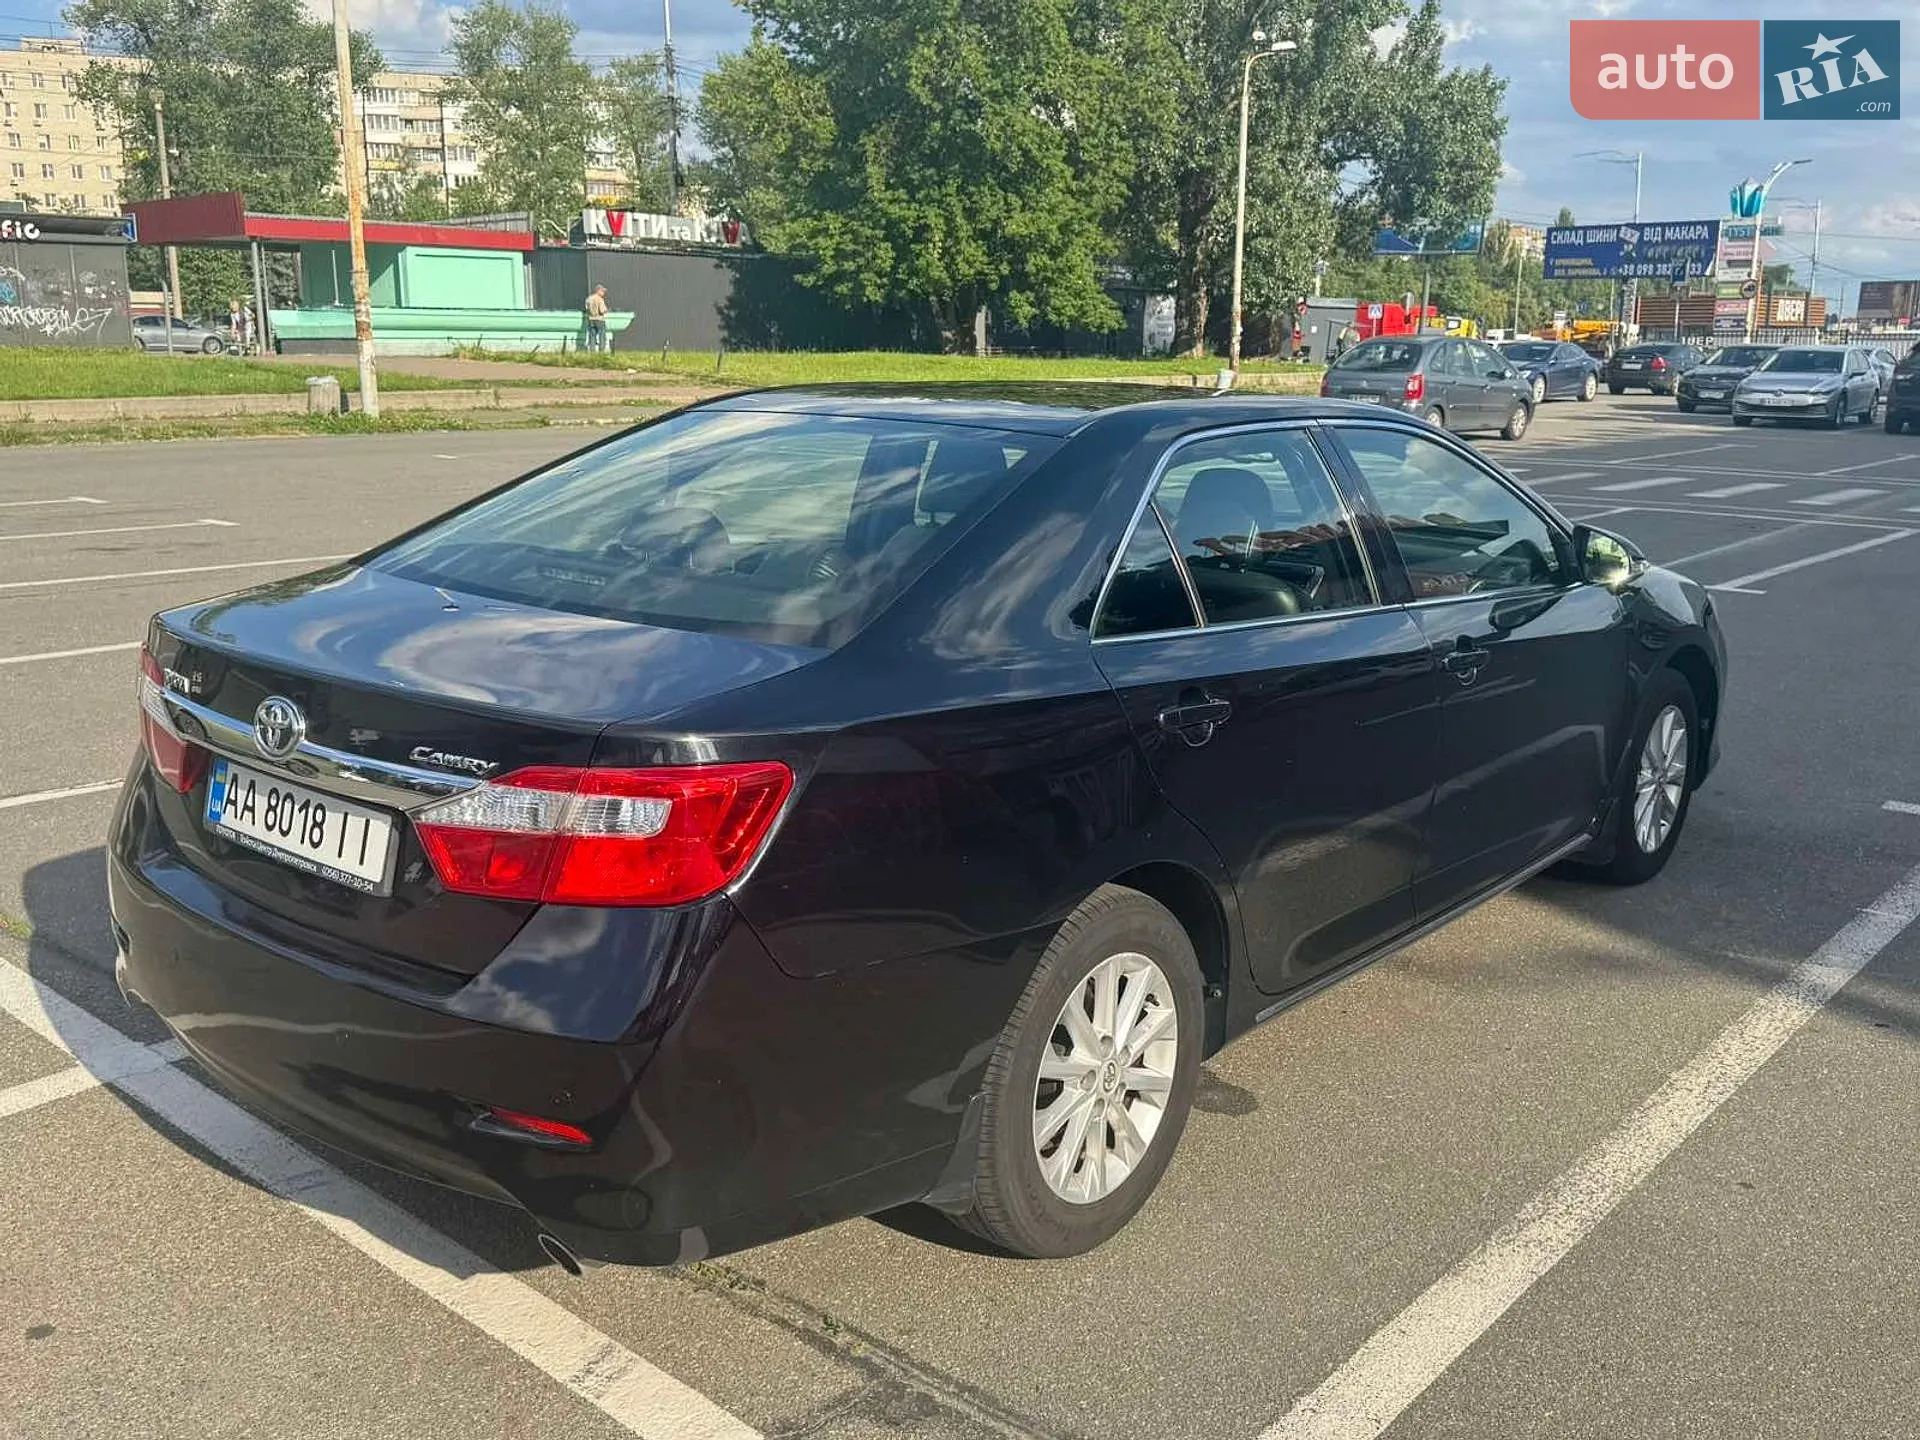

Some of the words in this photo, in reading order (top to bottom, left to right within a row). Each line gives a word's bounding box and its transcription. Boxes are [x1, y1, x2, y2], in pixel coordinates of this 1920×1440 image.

[670, 225, 692, 240] та
[1551, 229, 1584, 246] СКЛАД
[1586, 227, 1617, 243] ШИНИ
[1643, 227, 1662, 243] ВІД
[1664, 224, 1709, 241] МАКАРА
[409, 746, 500, 775] CAMRY
[212, 797, 222, 814] UA
[264, 787, 327, 850] 8018
